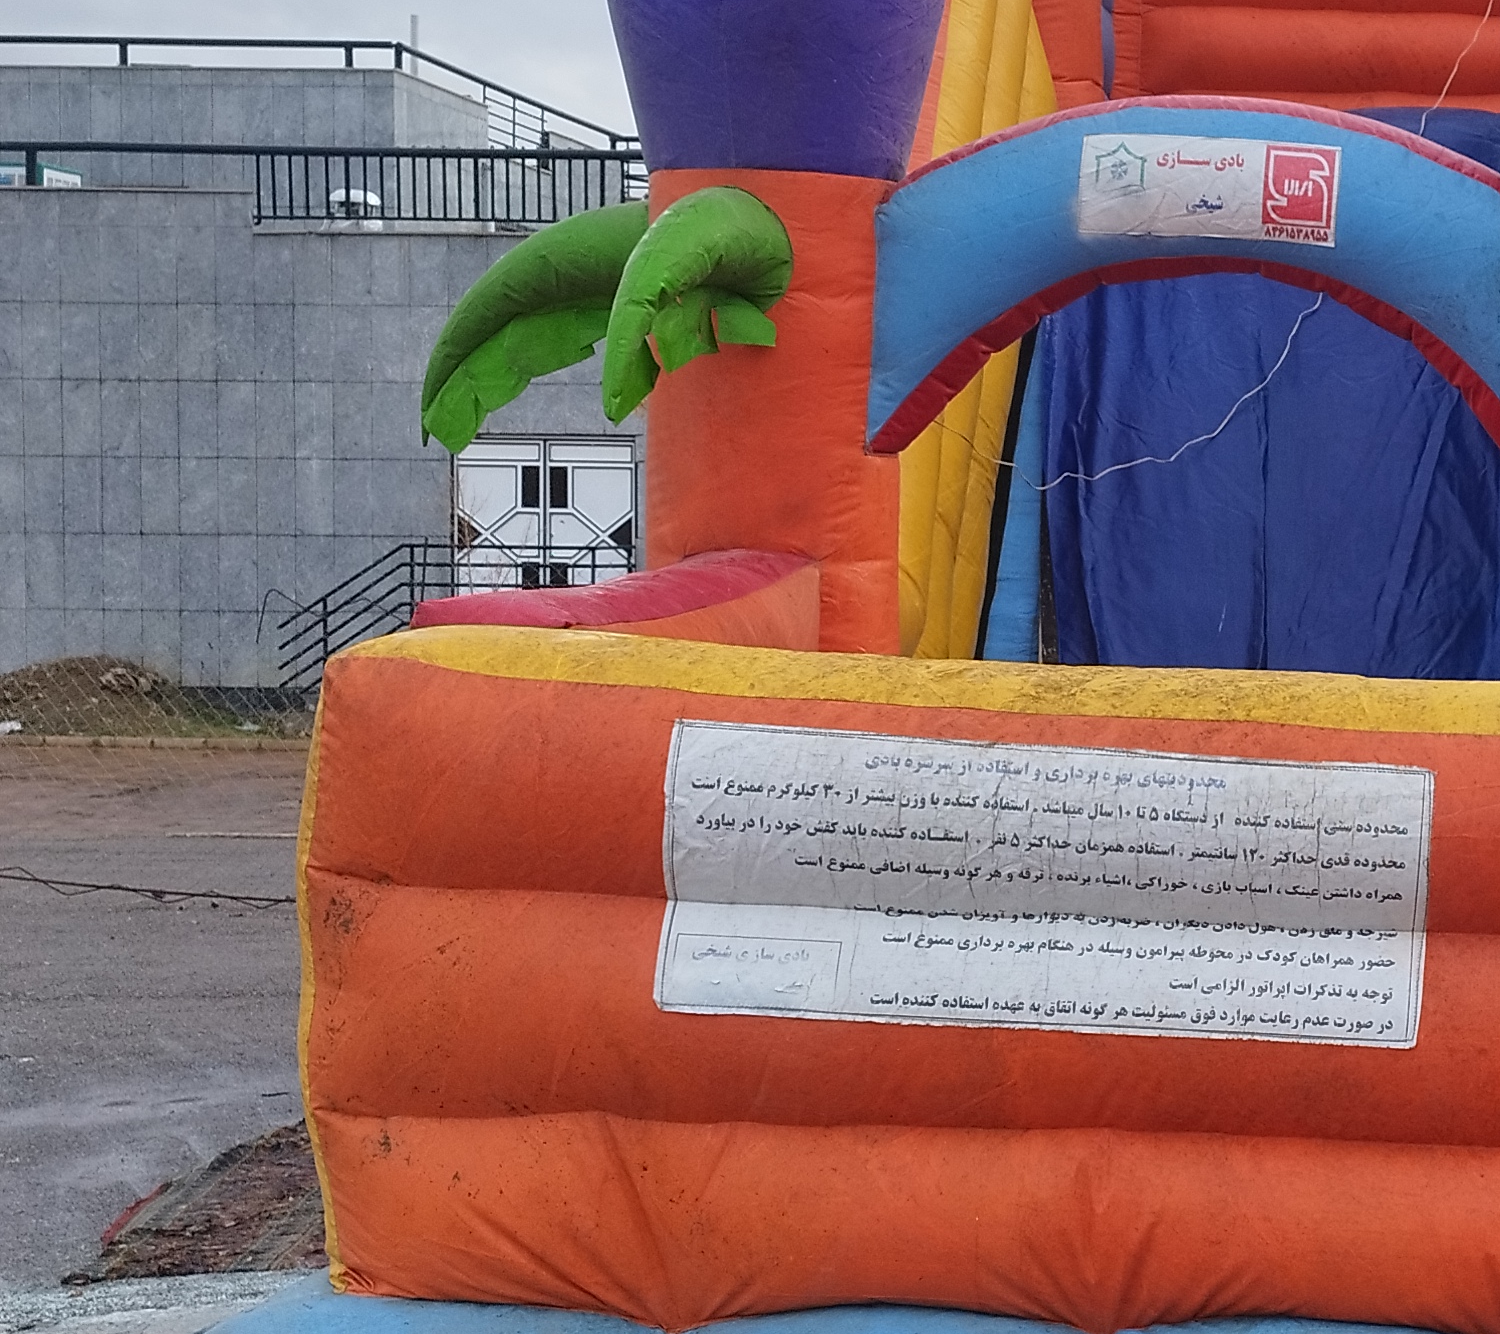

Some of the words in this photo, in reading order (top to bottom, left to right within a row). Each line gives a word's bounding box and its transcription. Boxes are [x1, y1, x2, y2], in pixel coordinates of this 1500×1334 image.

[1156, 150, 1212, 169] سازی
[1214, 153, 1245, 172] بادی
[864, 752, 901, 772] بادی
[957, 759, 972, 777] از
[976, 759, 1030, 777] استفاده
[690, 776, 722, 790] است
[1031, 768, 1042, 782] و
[723, 779, 765, 797] ممنوع
[766, 782, 820, 801] کیلوگرم
[822, 782, 842, 799] ۳۰
[844, 786, 860, 805] از
[861, 788, 896, 807] بیشتر
[898, 793, 926, 810] وزن
[930, 791, 940, 806] با
[942, 793, 980, 809] کننده
[982, 795, 1030, 812] استفاده
[1041, 800, 1084, 819] میباشد
[1087, 802, 1114, 821] سال
[1118, 804, 1131, 820] ۱۰
[1136, 805, 1147, 819] تا
[1148, 806, 1160, 822] ۵
[1163, 808, 1209, 824] دستگاه
[695, 812, 736, 831] بیاورد
[738, 817, 756, 833] در
[759, 815, 772, 834] را
[774, 818, 803, 836] خود
[805, 819, 839, 837] کفش
[1211, 811, 1225, 830] از
[1234, 813, 1271, 828] کننده
[1274, 814, 1322, 832] استفاده
[1323, 820, 1353, 836] سنی
[842, 822, 868, 837] باید
[870, 826, 908, 839] کننده
[1355, 822, 1409, 839] محدوده
[987, 831, 1007, 850] نفر
[1010, 833, 1021, 849] ۵
[1024, 834, 1072, 854] حداکثر
[1074, 837, 1125, 857] همزمان
[1127, 841, 1176, 857] استفاده
[794, 854, 823, 867] است
[1187, 846, 1239, 863] سانتیمتر
[1269, 849, 1319, 869] حداکثر
[1320, 852, 1351, 870] قدی
[826, 857, 866, 873] ممنوع
[869, 858, 911, 875] اضافی
[914, 862, 950, 880] وسیله
[1353, 855, 1406, 873] محدوده
[985, 868, 1002, 882] هر
[1005, 872, 1014, 883] و
[1056, 871, 1092, 886] برنده
[1134, 874, 1188, 892] خوراکی
[1200, 880, 1232, 895] بازی
[1234, 881, 1273, 895] اسباب
[1284, 884, 1321, 897] عینک
[1322, 887, 1363, 901] داشتن
[1365, 888, 1403, 904] همراه
[852, 903, 882, 913] است
[883, 906, 925, 918] ممنوع
[1010, 913, 1019, 924] و
[882, 931, 912, 944] است
[913, 933, 955, 949] ممنوع
[1344, 929, 1353, 940] و
[956, 934, 1005, 953] برداری
[1007, 940, 1035, 954] بهره
[1037, 938, 1075, 955] هنگام
[1076, 942, 1094, 957] در
[1097, 941, 1133, 959] وسیله
[1135, 945, 1185, 962] پیرامون
[1188, 945, 1234, 963] محوطه
[1235, 950, 1253, 964] در
[1256, 949, 1298, 967] کودک
[1299, 951, 1355, 969] همراهان
[1357, 955, 1396, 971] حضور
[1168, 976, 1199, 990] است
[1200, 977, 1245, 996] الزامی
[1247, 980, 1291, 1000] اپراتور
[1293, 982, 1343, 1001] تذکرات
[869, 991, 899, 1005] است
[901, 993, 940, 1008] کننده
[941, 995, 990, 1010] استفاده
[1345, 988, 1359, 1003] به
[1361, 987, 1394, 1005] توجه
[991, 1000, 1025, 1015] عهده
[1028, 1001, 1042, 1017] به
[1043, 999, 1077, 1018] اتفاق
[1079, 1001, 1109, 1021] گونه
[1112, 1006, 1129, 1021] هر
[1131, 1004, 1187, 1023] مسئولیت
[1190, 1005, 1216, 1025] فوق
[1219, 1007, 1256, 1027] موارد
[1259, 1010, 1300, 1030] رعایت
[1302, 1015, 1330, 1031] عدم
[1333, 1016, 1374, 1034] صورت
[1376, 1019, 1394, 1035] در
